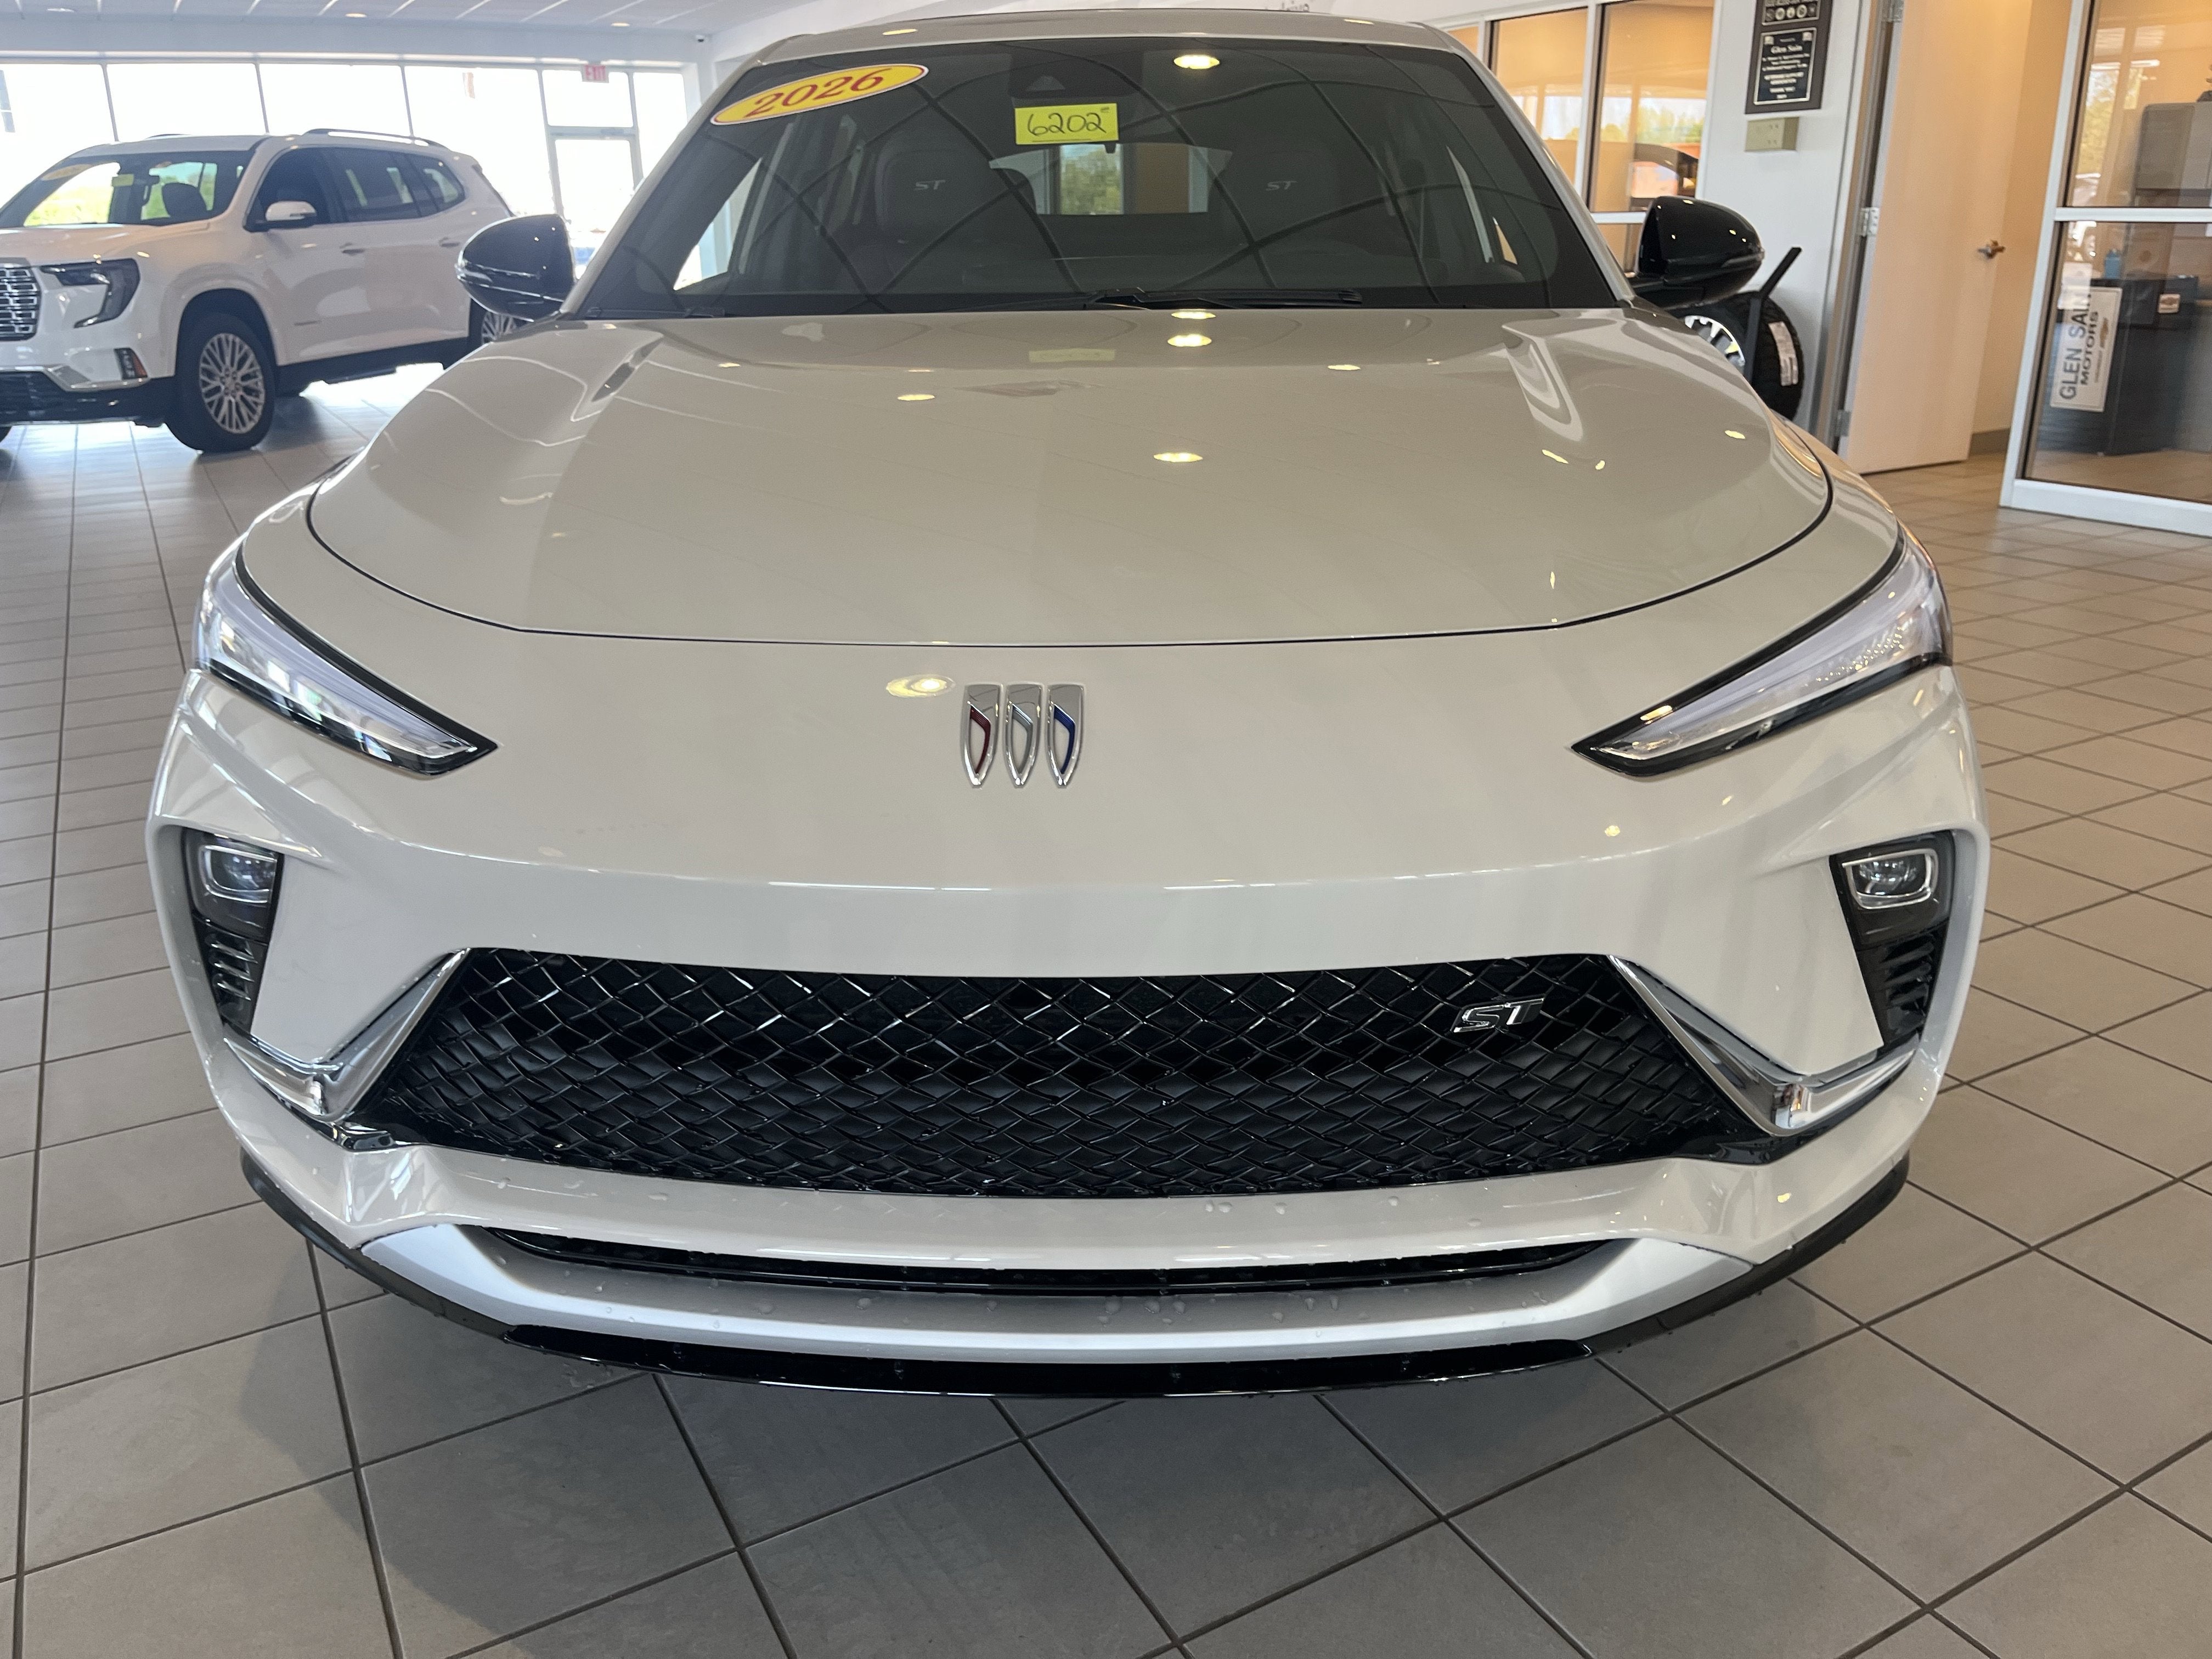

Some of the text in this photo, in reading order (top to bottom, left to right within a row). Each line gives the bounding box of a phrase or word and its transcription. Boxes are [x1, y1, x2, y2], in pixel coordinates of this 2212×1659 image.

[743, 67, 893, 119] 2026
[1027, 112, 1107, 137] 6202
[915, 179, 946, 190] ST
[1265, 180, 1299, 191] ST
[2059, 294, 2092, 400] GLEN SAI
[1453, 996, 1545, 1034] ST
